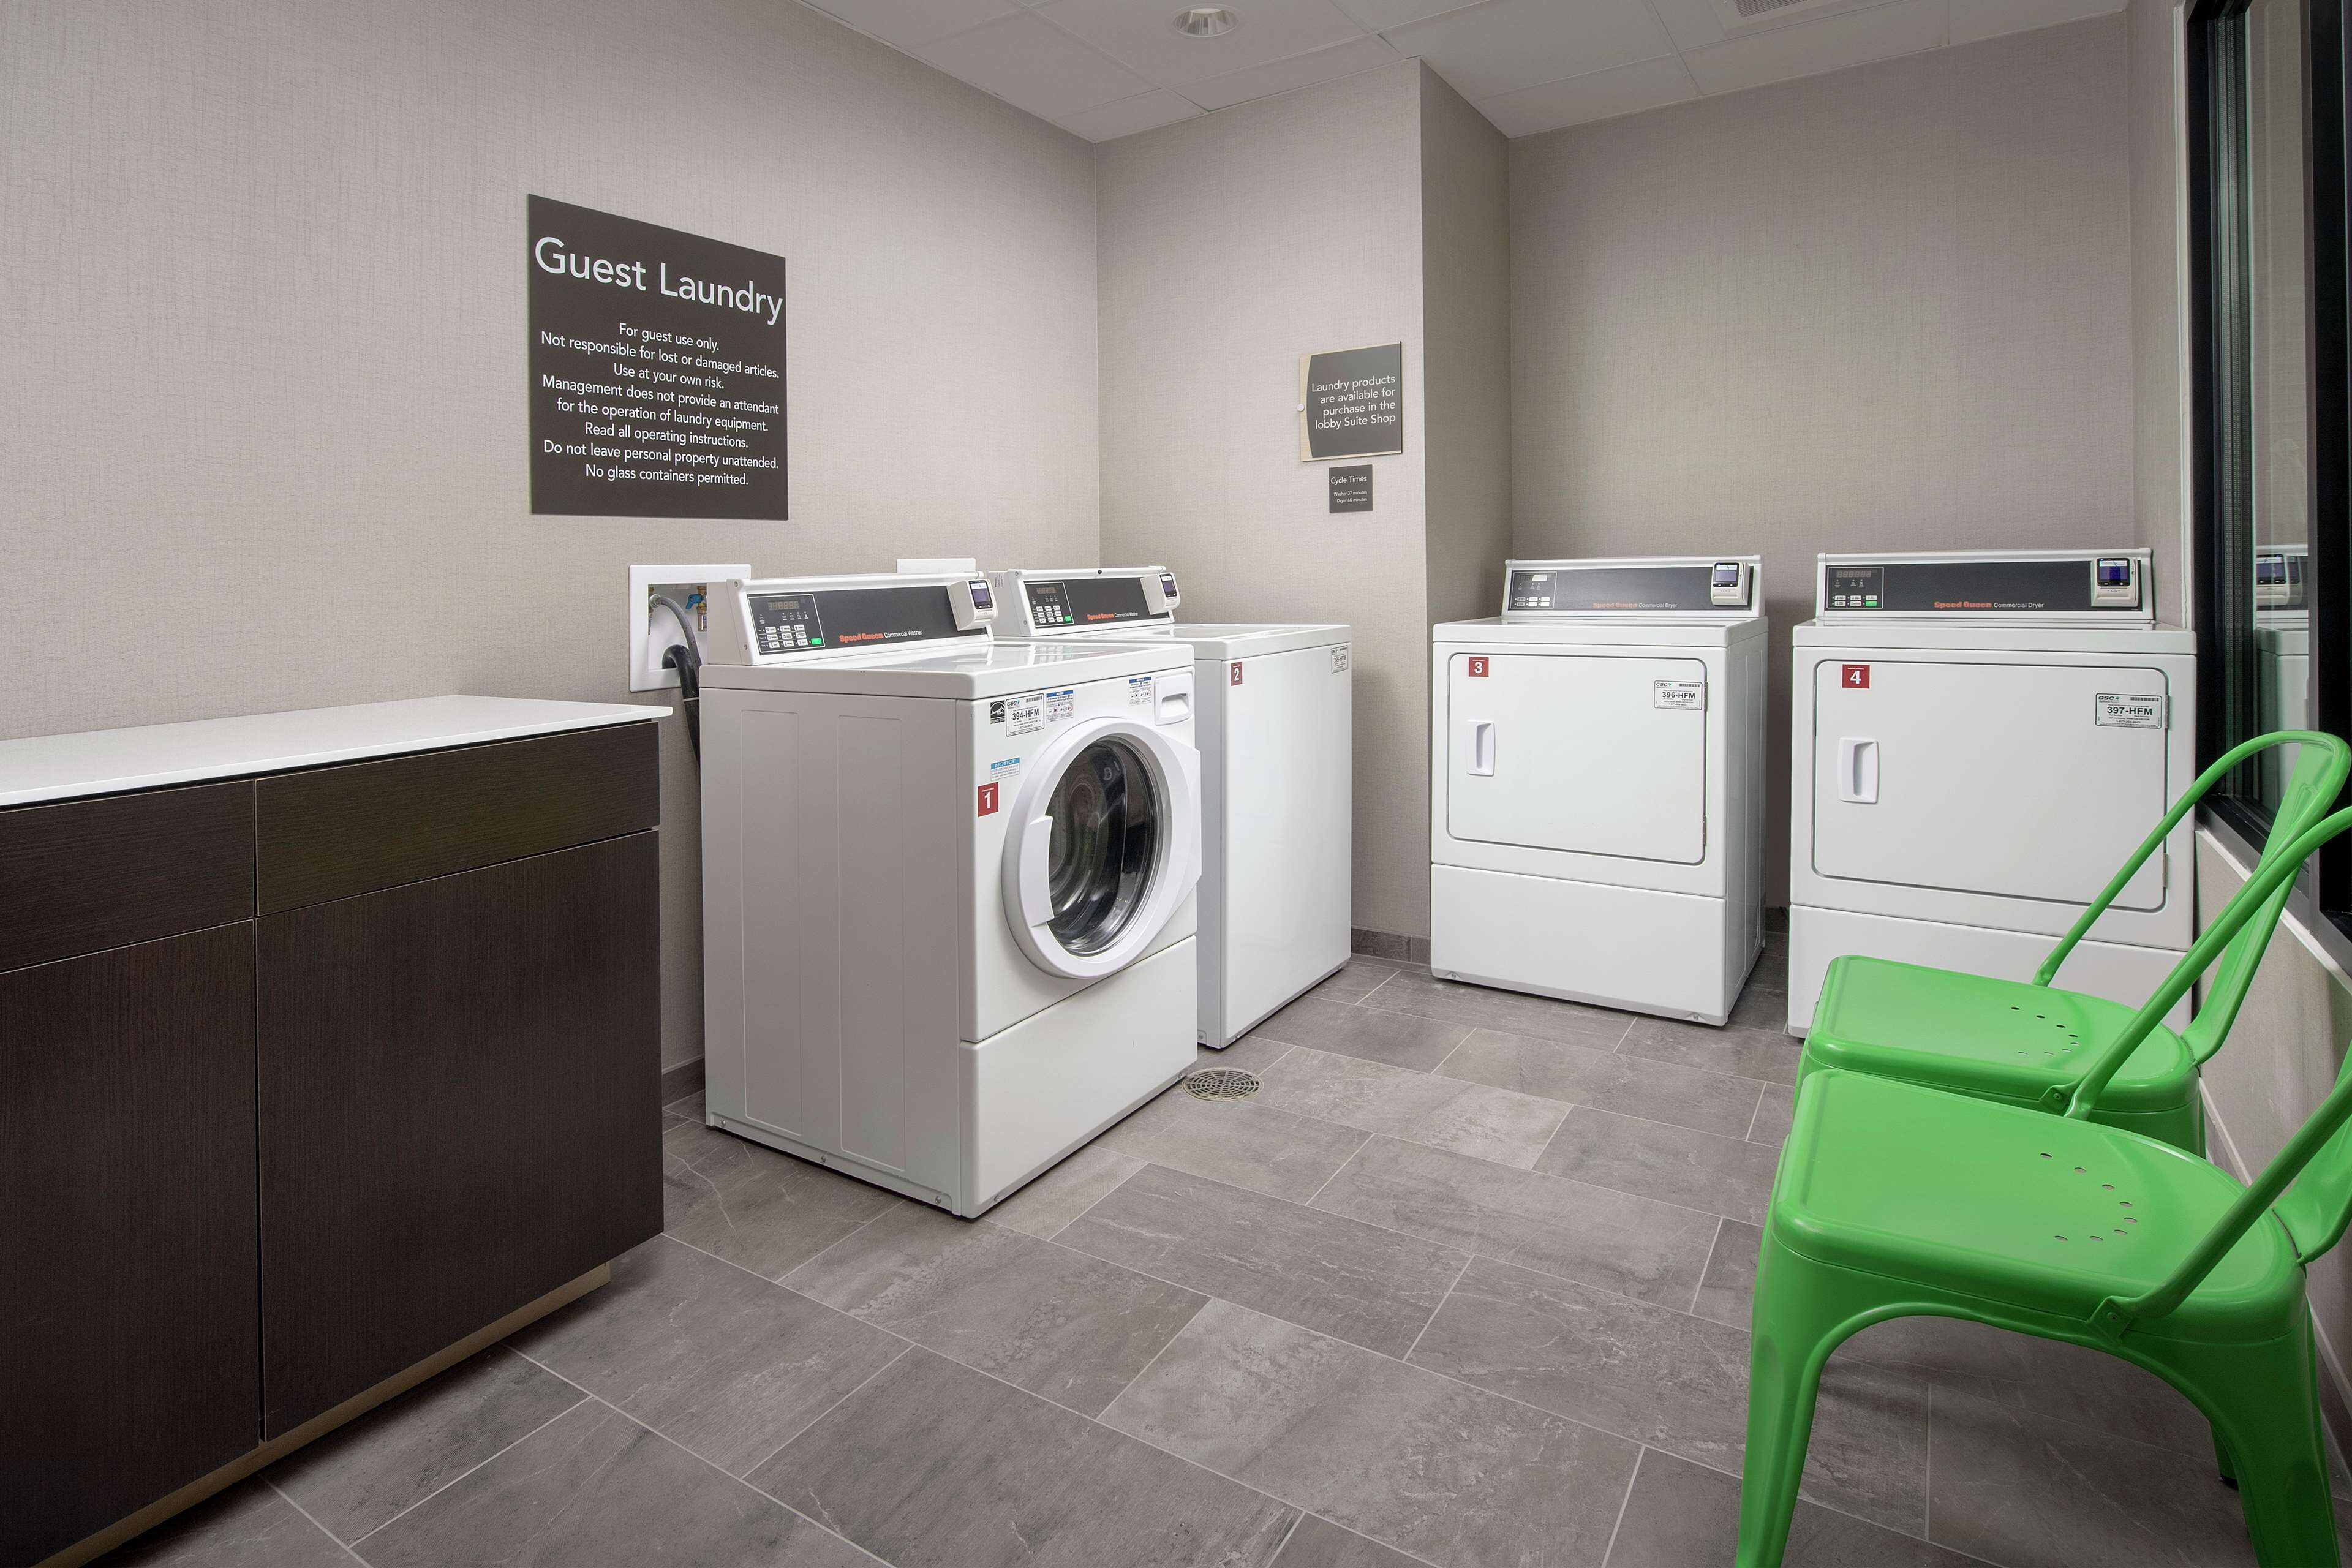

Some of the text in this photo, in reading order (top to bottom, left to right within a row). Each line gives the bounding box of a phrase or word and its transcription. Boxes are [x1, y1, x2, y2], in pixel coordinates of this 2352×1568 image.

[535, 237, 783, 325] Guest Laundry
[620, 323, 719, 353] For guest use only.
[541, 331, 779, 378] Not responsible for lost or damaged articles.
[614, 363, 724, 389] Use at your own risk.
[1312, 375, 1395, 392] Laundry products
[543, 374, 779, 415] Management does not provide an attendant
[1338, 388, 1379, 402] available
[1381, 387, 1396, 397] for
[557, 397, 768, 432] for the operation of laundry equipment.
[1323, 400, 1396, 419] purchase in the
[1316, 413, 1396, 430] lobby Suite Shop
[586, 422, 748, 448] Read all operating instructions.
[544, 440, 778, 469] Do not leave personal property unattended.
[586, 464, 748, 486] No glass containers permitted.
[1330, 476, 1348, 485] Cycle
[840, 634, 862, 643] Speed
[1234, 668, 1240, 681] 2
[1474, 662, 1483, 674] 3
[1850, 670, 1861, 684] 4
[1012, 708, 1039, 721] 394-HFM
[2107, 706, 2152, 715] 397-HFM
[995, 759, 1016, 767] NOTICE
[984, 791, 990, 809] 1
